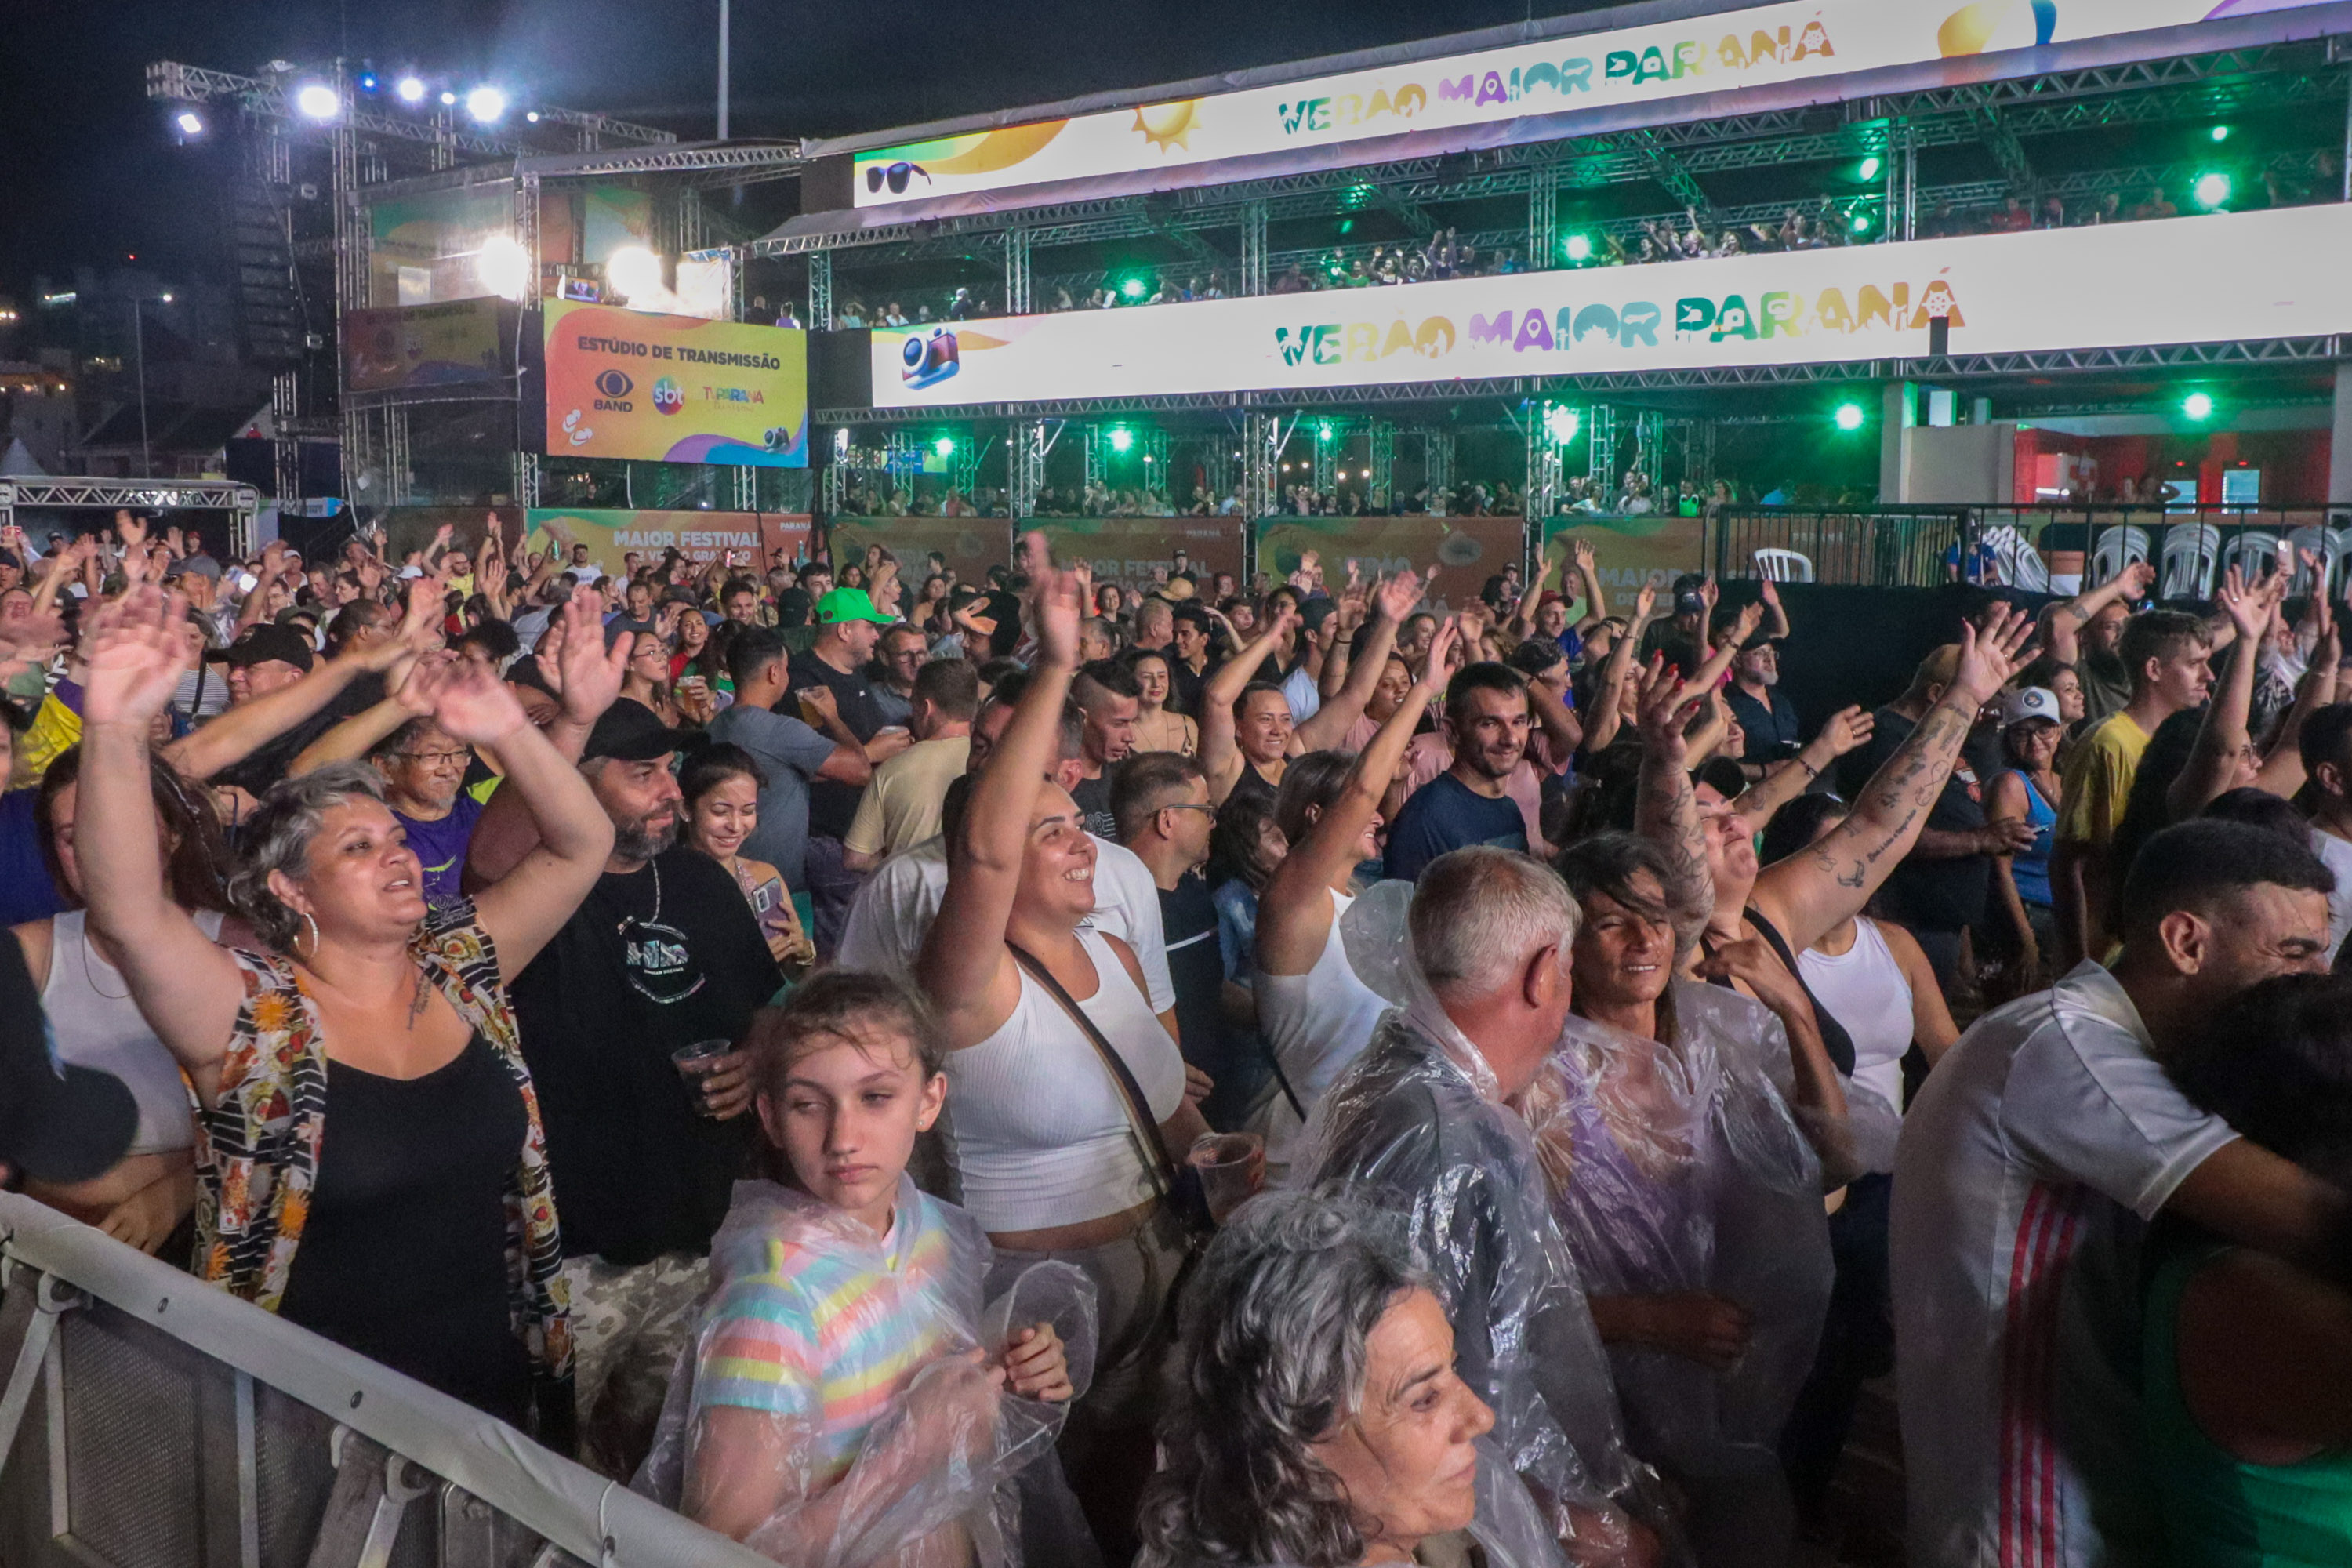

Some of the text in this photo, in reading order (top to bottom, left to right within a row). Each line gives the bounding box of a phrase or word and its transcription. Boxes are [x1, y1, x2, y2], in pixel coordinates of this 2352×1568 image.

[1439, 56, 1593, 107] MAIOR
[1604, 10, 1835, 85] PARANÁ
[1469, 300, 1662, 352] MAIOR
[1675, 267, 1966, 343] PARANÁ
[577, 336, 781, 370] ESTÚDIO DE TRANSMISSÃO
[593, 399, 633, 412] BAND
[655, 380, 684, 405] sbt
[613, 531, 761, 548] MAIOR FESTIVAL
